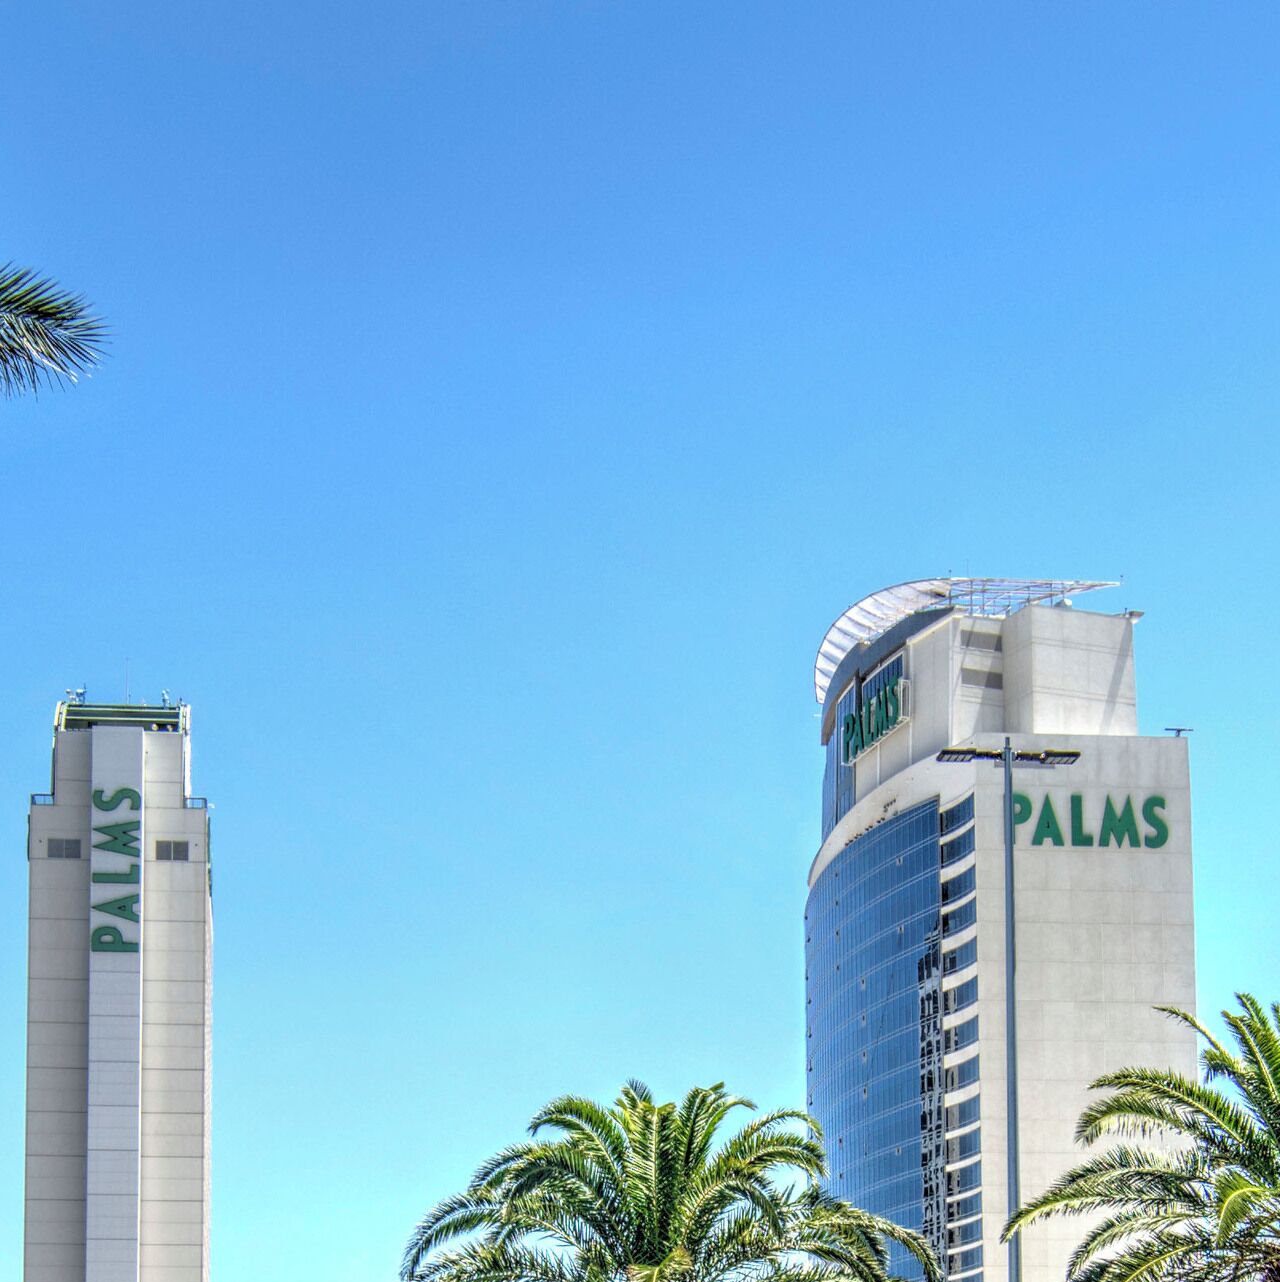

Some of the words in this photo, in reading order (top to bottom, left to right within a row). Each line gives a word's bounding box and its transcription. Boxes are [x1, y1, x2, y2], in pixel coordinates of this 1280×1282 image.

[842, 674, 899, 764] PALMS
[1004, 793, 1169, 849] PALMS
[91, 788, 142, 952] PALMS
